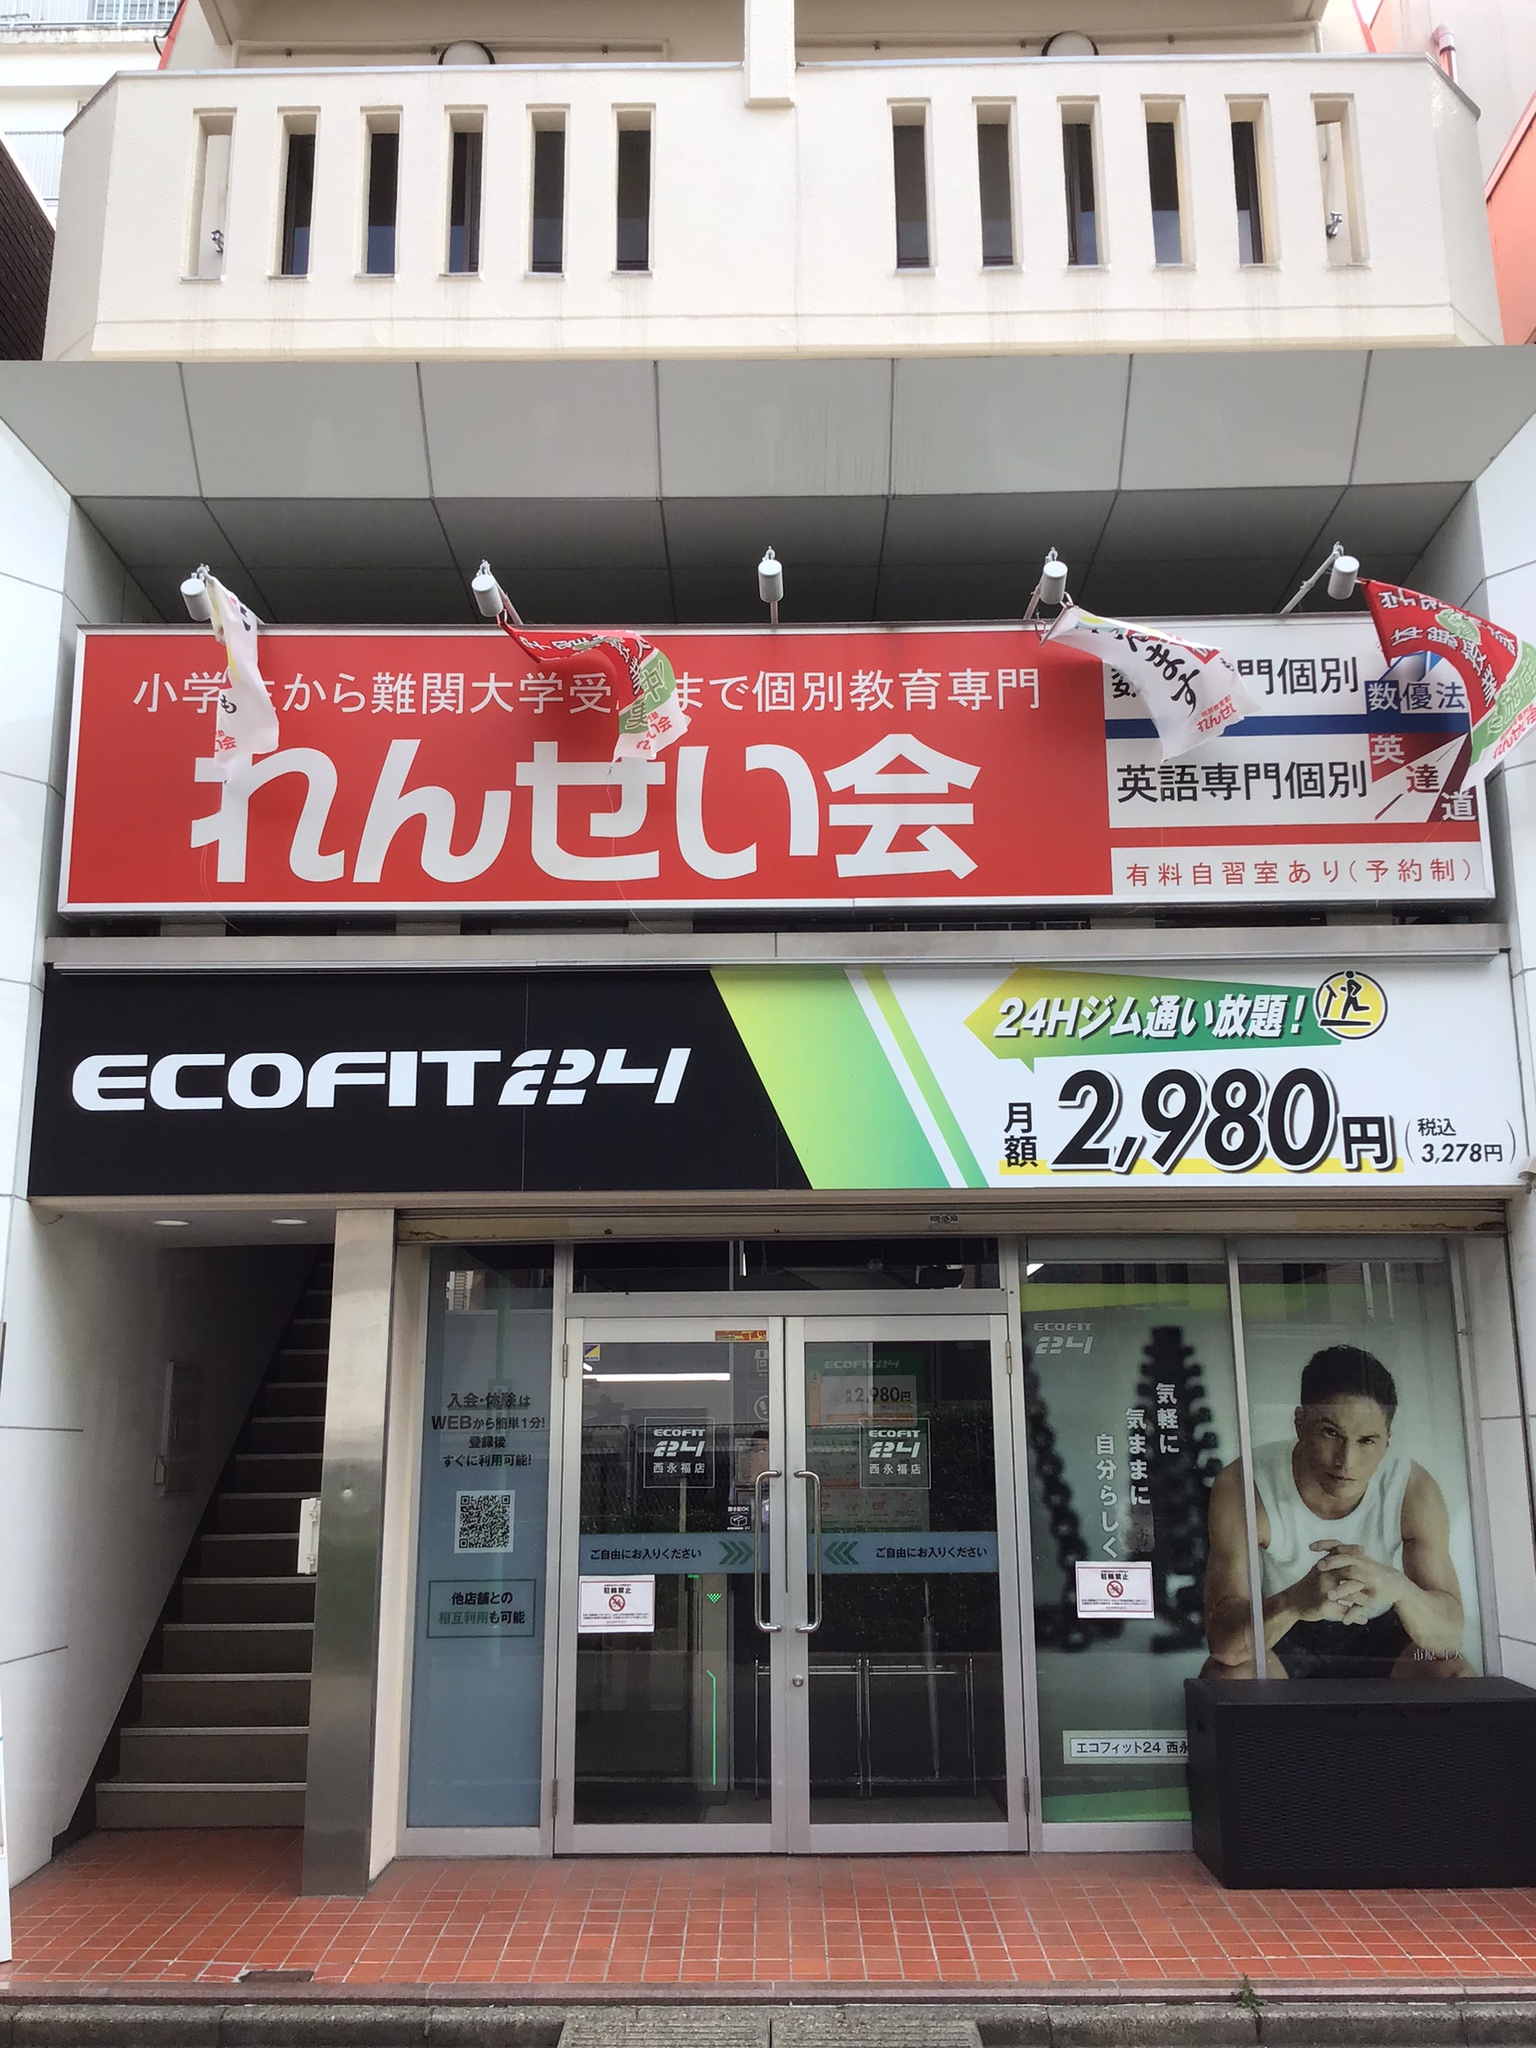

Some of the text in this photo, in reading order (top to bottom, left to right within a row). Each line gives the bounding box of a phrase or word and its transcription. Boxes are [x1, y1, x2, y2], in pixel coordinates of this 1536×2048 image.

[133, 667, 1042, 719] 小学から難関大学受まで個別教育専門
[1367, 680, 1466, 712] 数優法
[1116, 760, 1369, 805] 英語専門個別
[190, 733, 982, 885] れんせい会
[1126, 856, 1474, 889] 有料自習室あり(予約制)
[994, 993, 1306, 1039] 24Hジム通い放題!
[71, 1047, 693, 1112] ECOFIT24
[1051, 1068, 1392, 1173] 2,980円
[1003, 1101, 1040, 1168] 月額
[1033, 1322, 1094, 1332] ECOFIT
[1034, 1336, 1094, 1355] 24
[1155, 1382, 1180, 1454] 気軽に
[468, 1436, 507, 1449] 登録後
[653, 1428, 706, 1437] ECOFIT
[868, 1429, 922, 1438] ECOFIT
[653, 1440, 706, 1457] 24
[868, 1441, 922, 1458] 24
[1125, 1407, 1151, 1506] 気ままに
[1095, 1433, 1120, 1559] 自分らしく
[590, 1548, 702, 1561] ご自由にお入りください
[875, 1546, 989, 1559] ご自由にお入りください
[451, 1591, 514, 1606] 他店舗との
[438, 1610, 526, 1625] 相互利用も可能
[1076, 1740, 1162, 1754] エコフィット24
